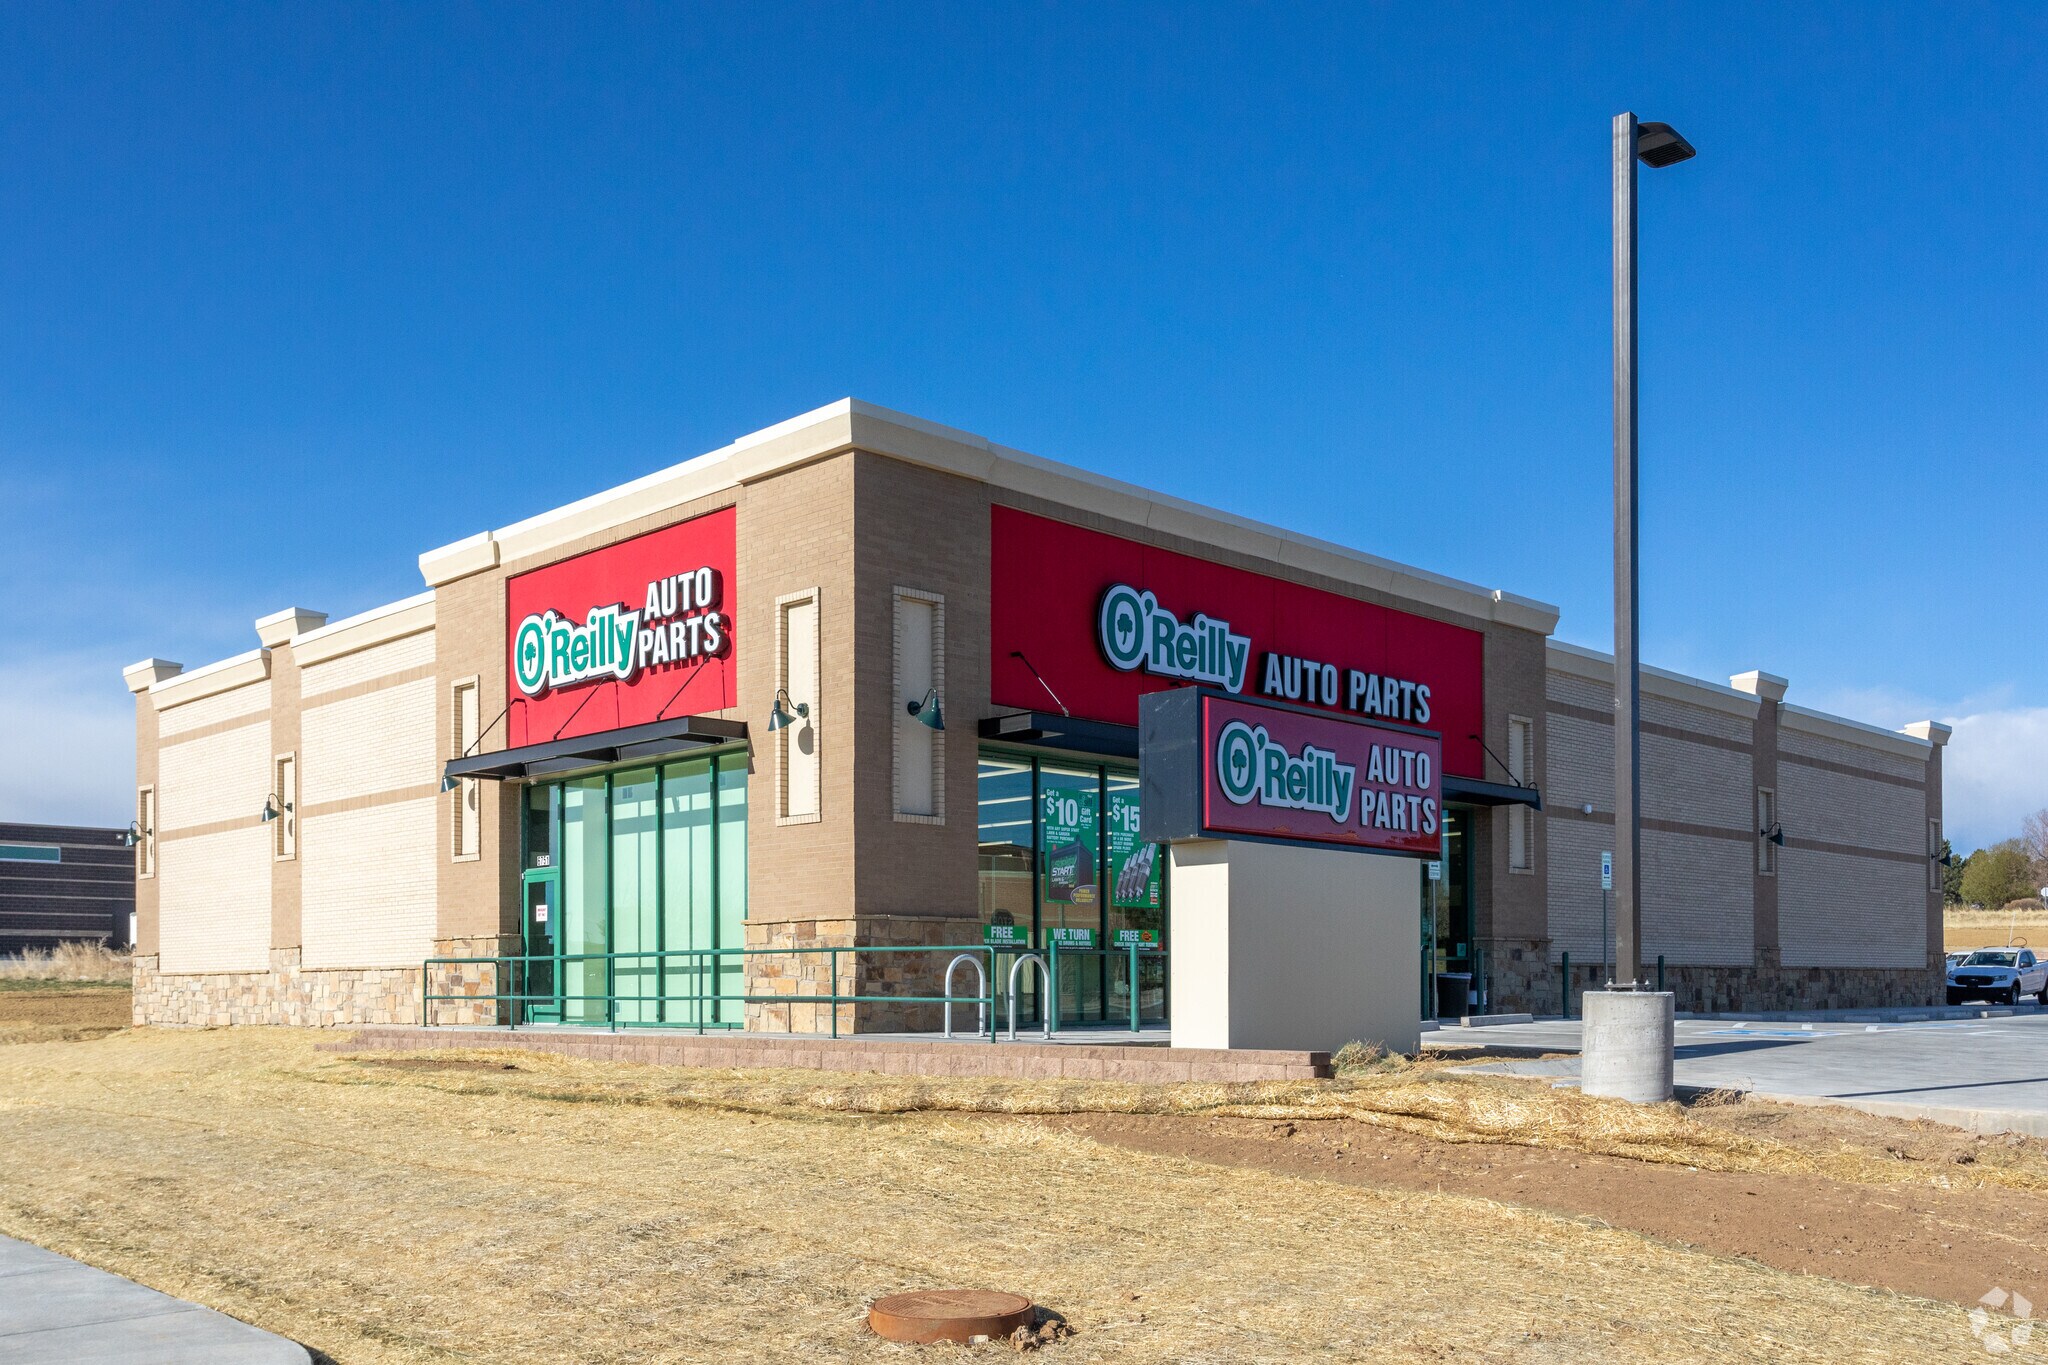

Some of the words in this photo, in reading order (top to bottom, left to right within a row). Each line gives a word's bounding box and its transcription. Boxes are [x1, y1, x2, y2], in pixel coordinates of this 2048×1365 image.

[644, 566, 713, 622] AUTO
[515, 608, 641, 694] O'Reilly
[638, 612, 722, 671] PARTS
[1101, 585, 1250, 693] O'Reilly
[1264, 652, 1338, 706] AUTO
[1350, 669, 1431, 724] PARTS
[1218, 722, 1355, 823] O'Reilly
[1367, 744, 1430, 790] AUTO
[1046, 797, 1079, 827] $10
[1112, 804, 1140, 832] $15
[1360, 790, 1437, 835] PARTS
[1052, 865, 1075, 877] START
[991, 926, 1014, 939] FREE
[1053, 928, 1067, 940] WE
[1069, 928, 1090, 941] TURN
[1120, 930, 1140, 942] FREE
